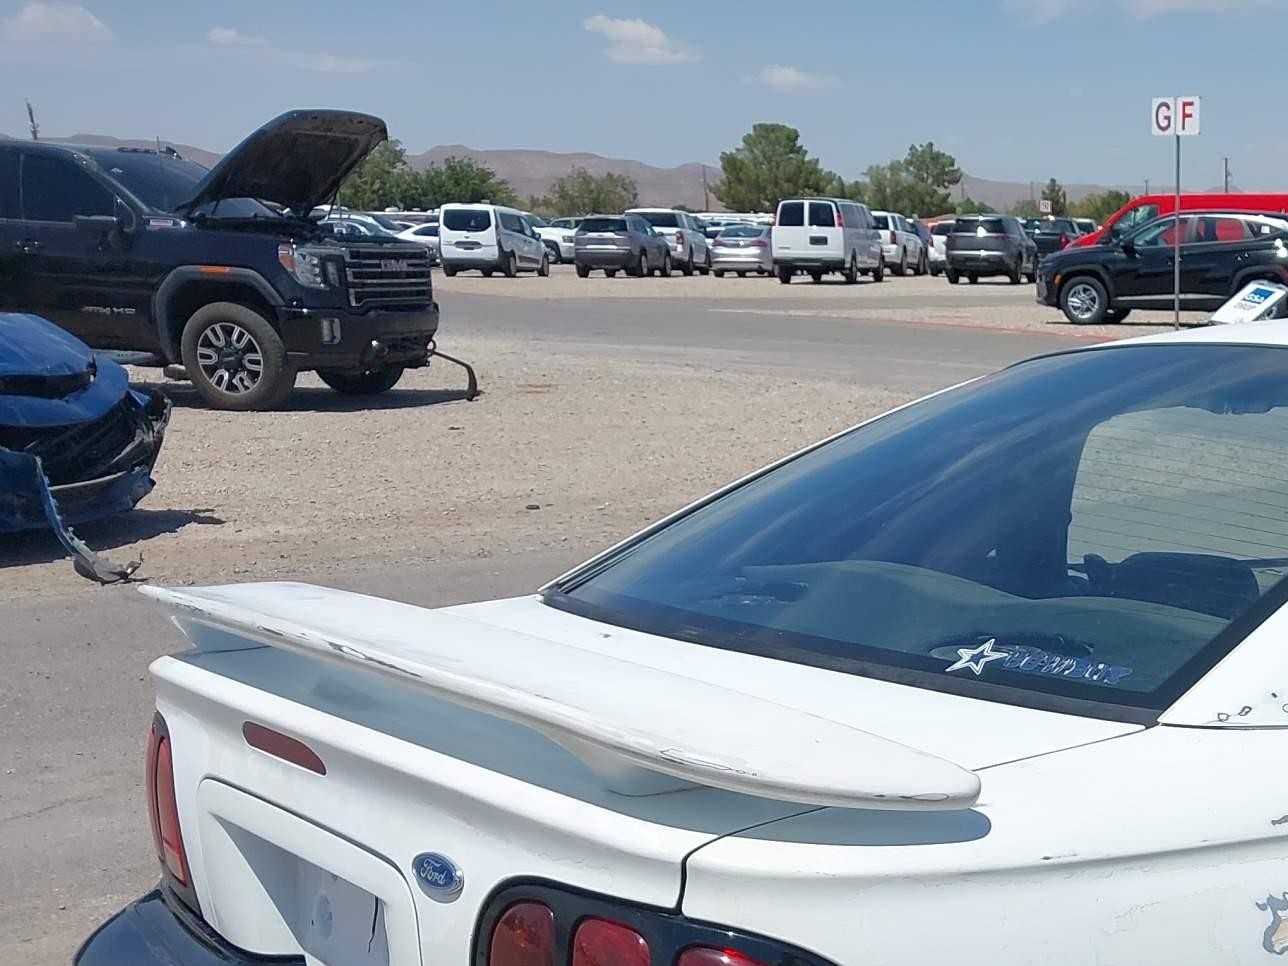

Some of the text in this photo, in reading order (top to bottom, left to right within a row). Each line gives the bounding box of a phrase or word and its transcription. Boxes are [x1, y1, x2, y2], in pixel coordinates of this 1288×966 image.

[1155, 101, 1194, 132] G F
[420, 858, 448, 885] Ford
